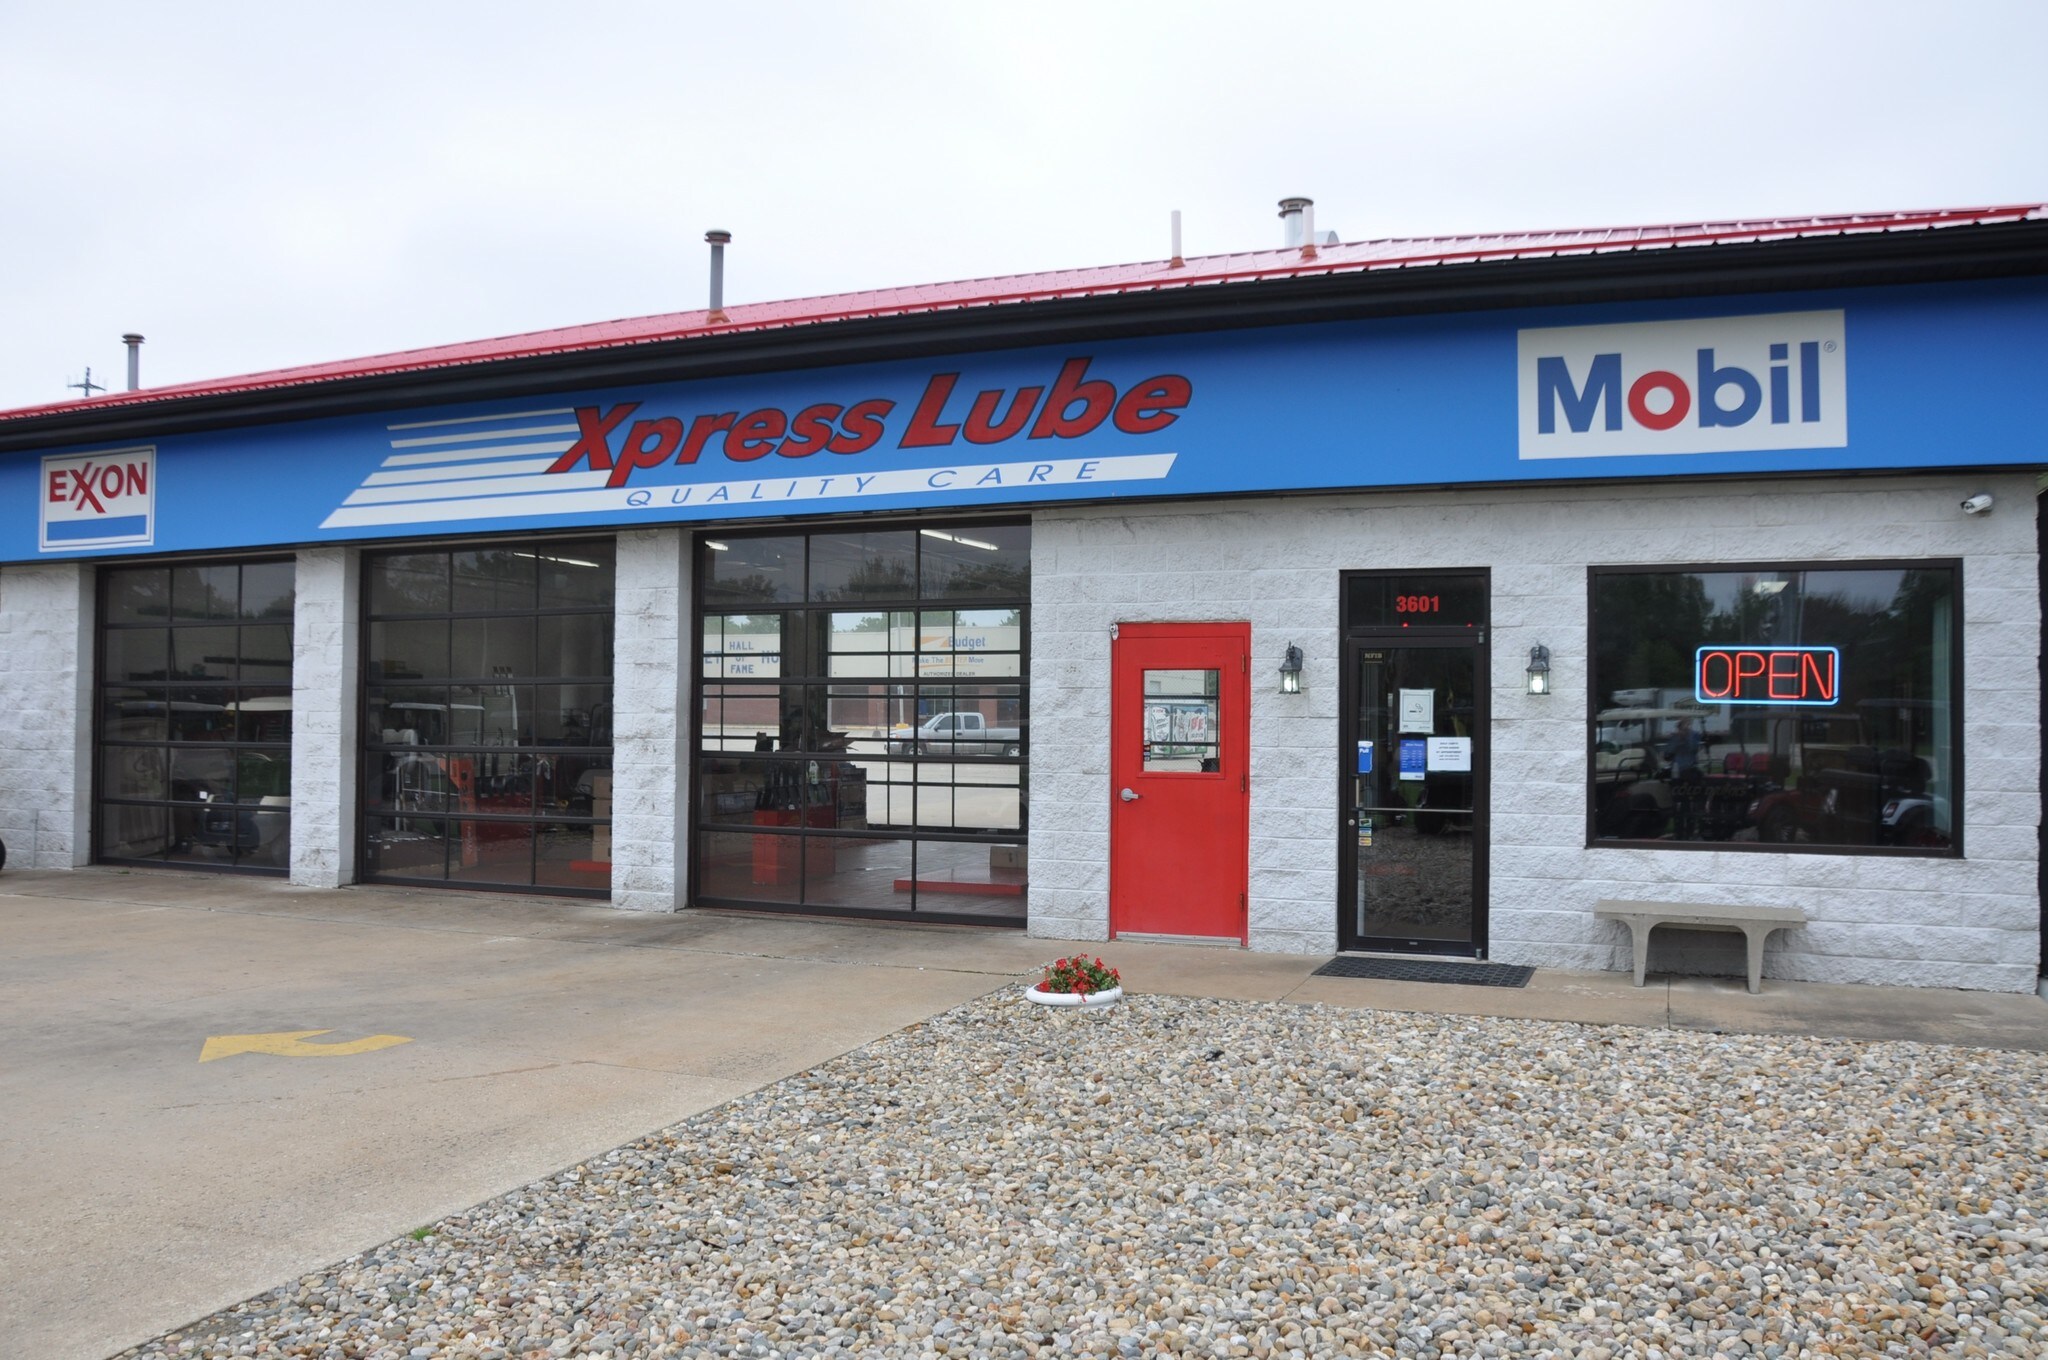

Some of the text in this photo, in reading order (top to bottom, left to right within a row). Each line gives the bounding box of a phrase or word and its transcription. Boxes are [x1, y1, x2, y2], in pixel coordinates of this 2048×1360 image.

[1537, 341, 1820, 434] Mobil
[543, 356, 1193, 488] Xpress Lube
[49, 462, 148, 514] EXXON
[626, 461, 1100, 507] QUALITY CARE
[1396, 595, 1439, 612] 3601
[729, 641, 754, 650] HALL
[948, 636, 985, 651] Budget
[730, 664, 754, 674] FAME
[932, 656, 944, 664] The
[968, 656, 984, 664] Move
[1702, 652, 1833, 699] OPEN
